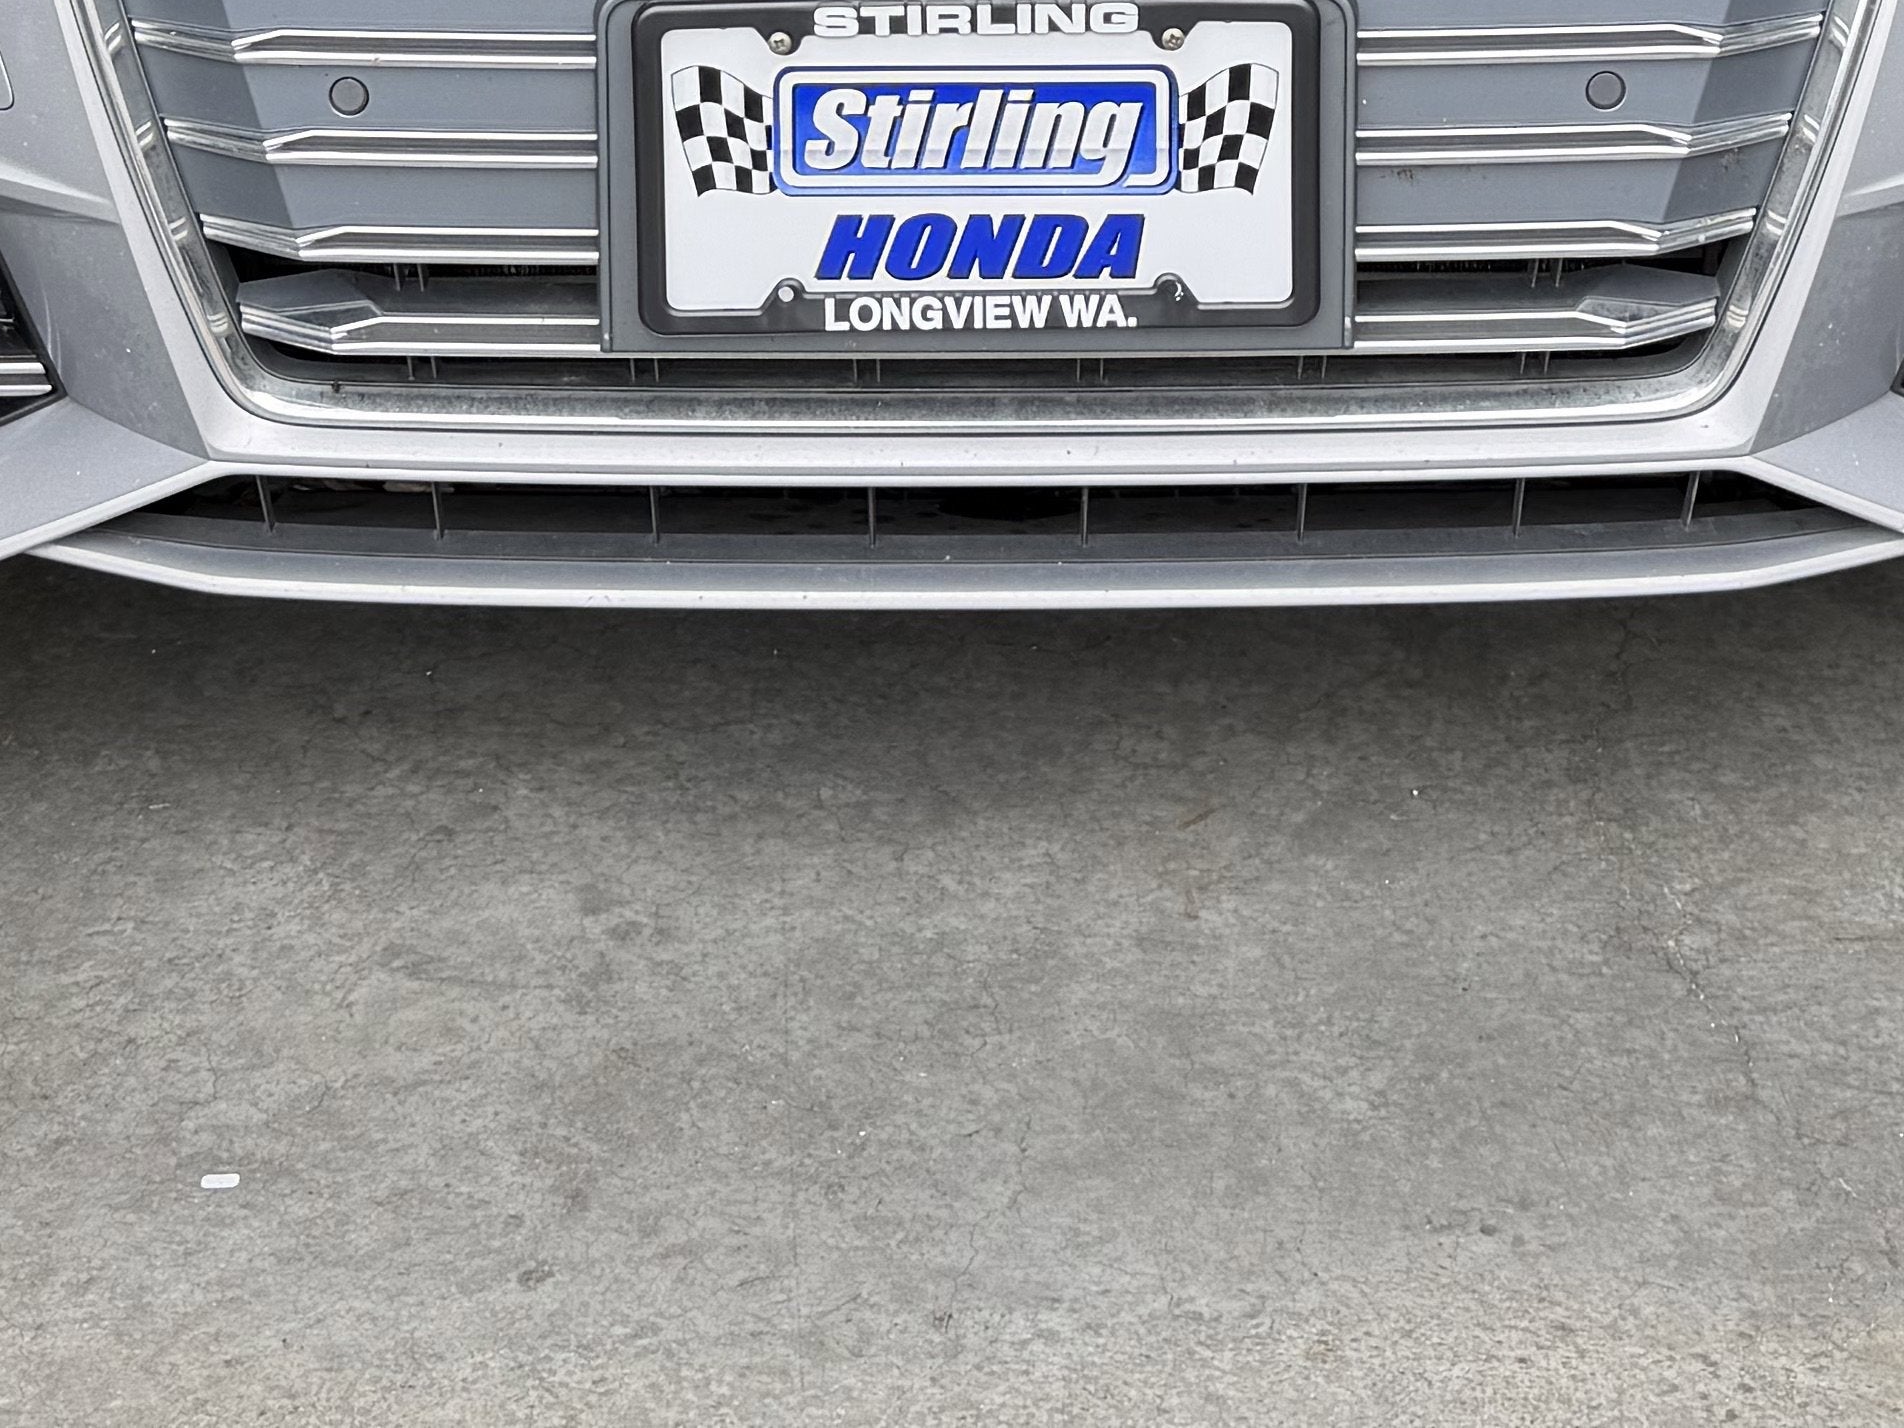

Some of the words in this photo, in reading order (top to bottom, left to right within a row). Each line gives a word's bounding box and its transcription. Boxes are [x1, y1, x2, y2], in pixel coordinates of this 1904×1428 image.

[813, 2, 1139, 36] STIRLING
[803, 88, 1145, 186] Stirling
[814, 213, 1145, 281] HONDA
[824, 295, 1052, 331] LONGVIEW
[1065, 293, 1138, 328] WA.
